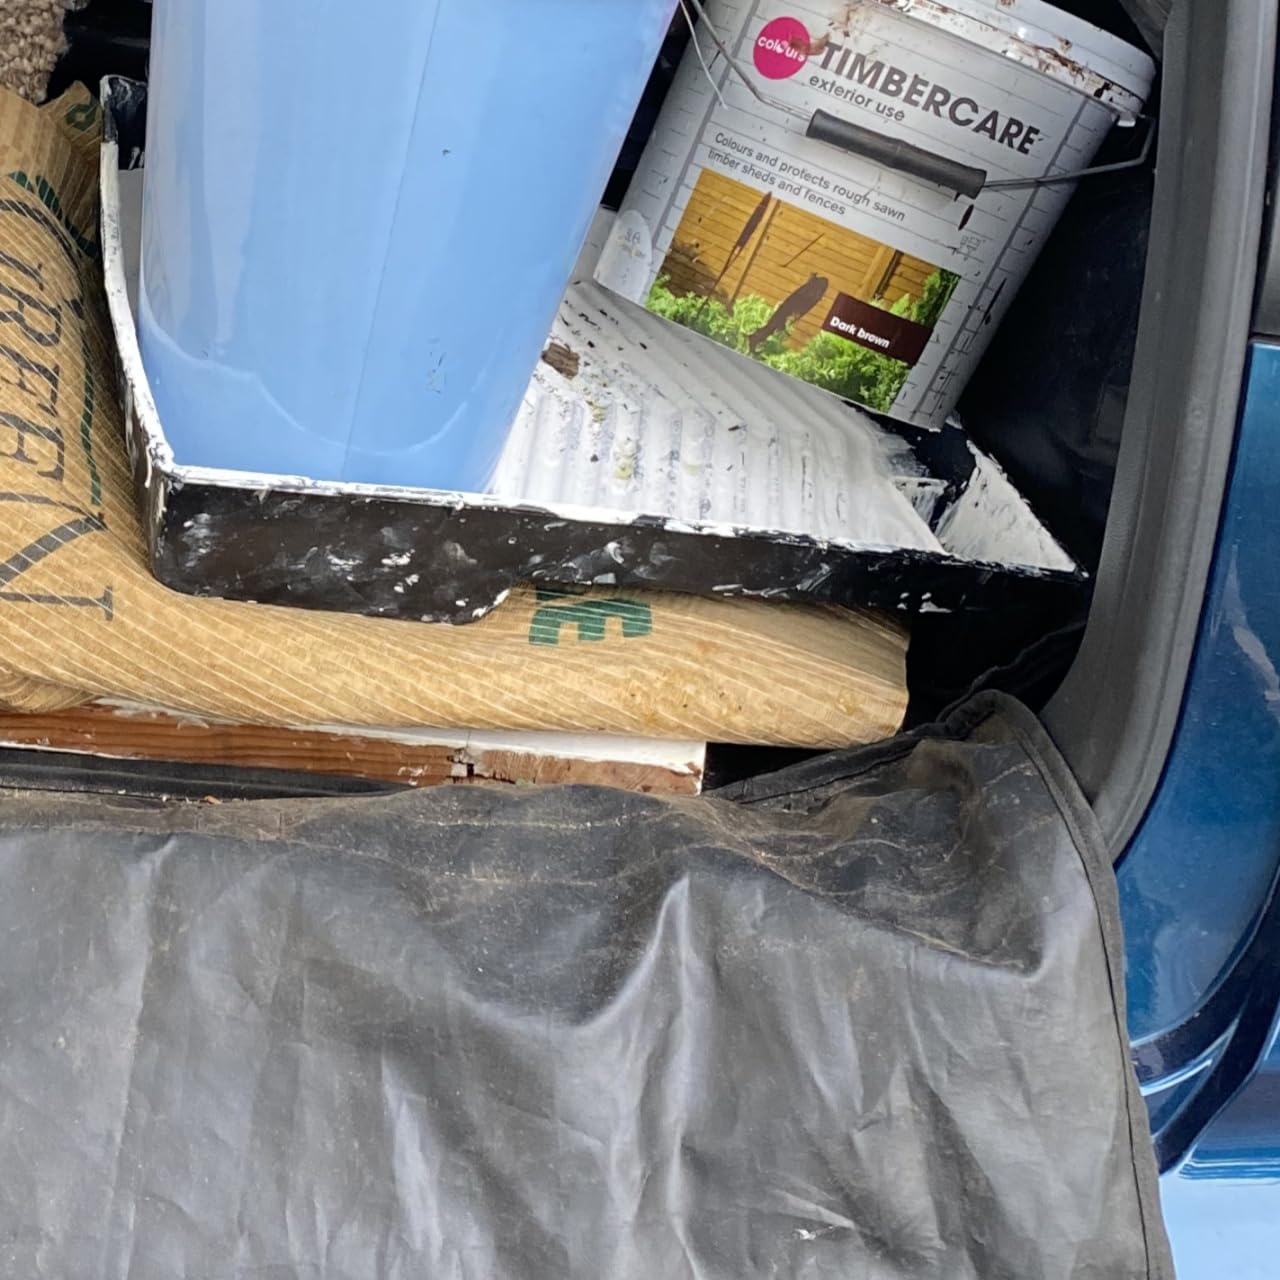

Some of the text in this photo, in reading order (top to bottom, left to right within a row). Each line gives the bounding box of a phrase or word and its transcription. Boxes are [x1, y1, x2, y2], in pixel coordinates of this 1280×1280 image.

[757, 35, 806, 62] colours
[809, 74, 905, 121] exterior use
[819, 42, 1041, 154] TIMBERCARE
[708, 149, 846, 216] timber sheds and fences
[715, 132, 906, 221] Colours and protects rough sawn
[830, 316, 890, 348] Dark brown
